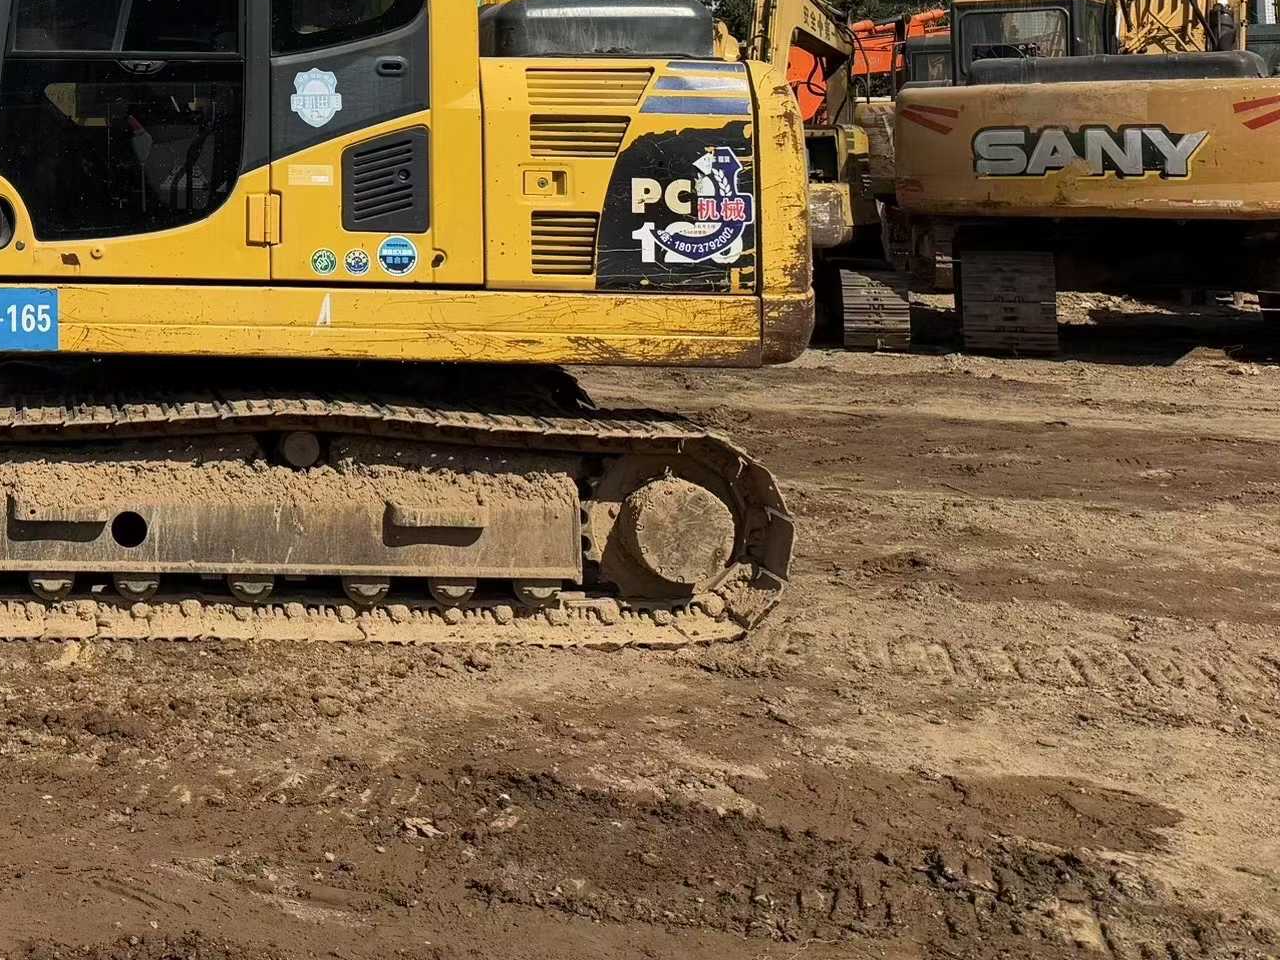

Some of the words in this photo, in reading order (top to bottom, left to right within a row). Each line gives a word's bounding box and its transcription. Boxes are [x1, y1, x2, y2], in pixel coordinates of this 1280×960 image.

[973, 126, 1210, 178] SANY
[631, 177, 692, 215] PC
[697, 197, 746, 221] 机械
[674, 226, 734, 253] 18073792002
